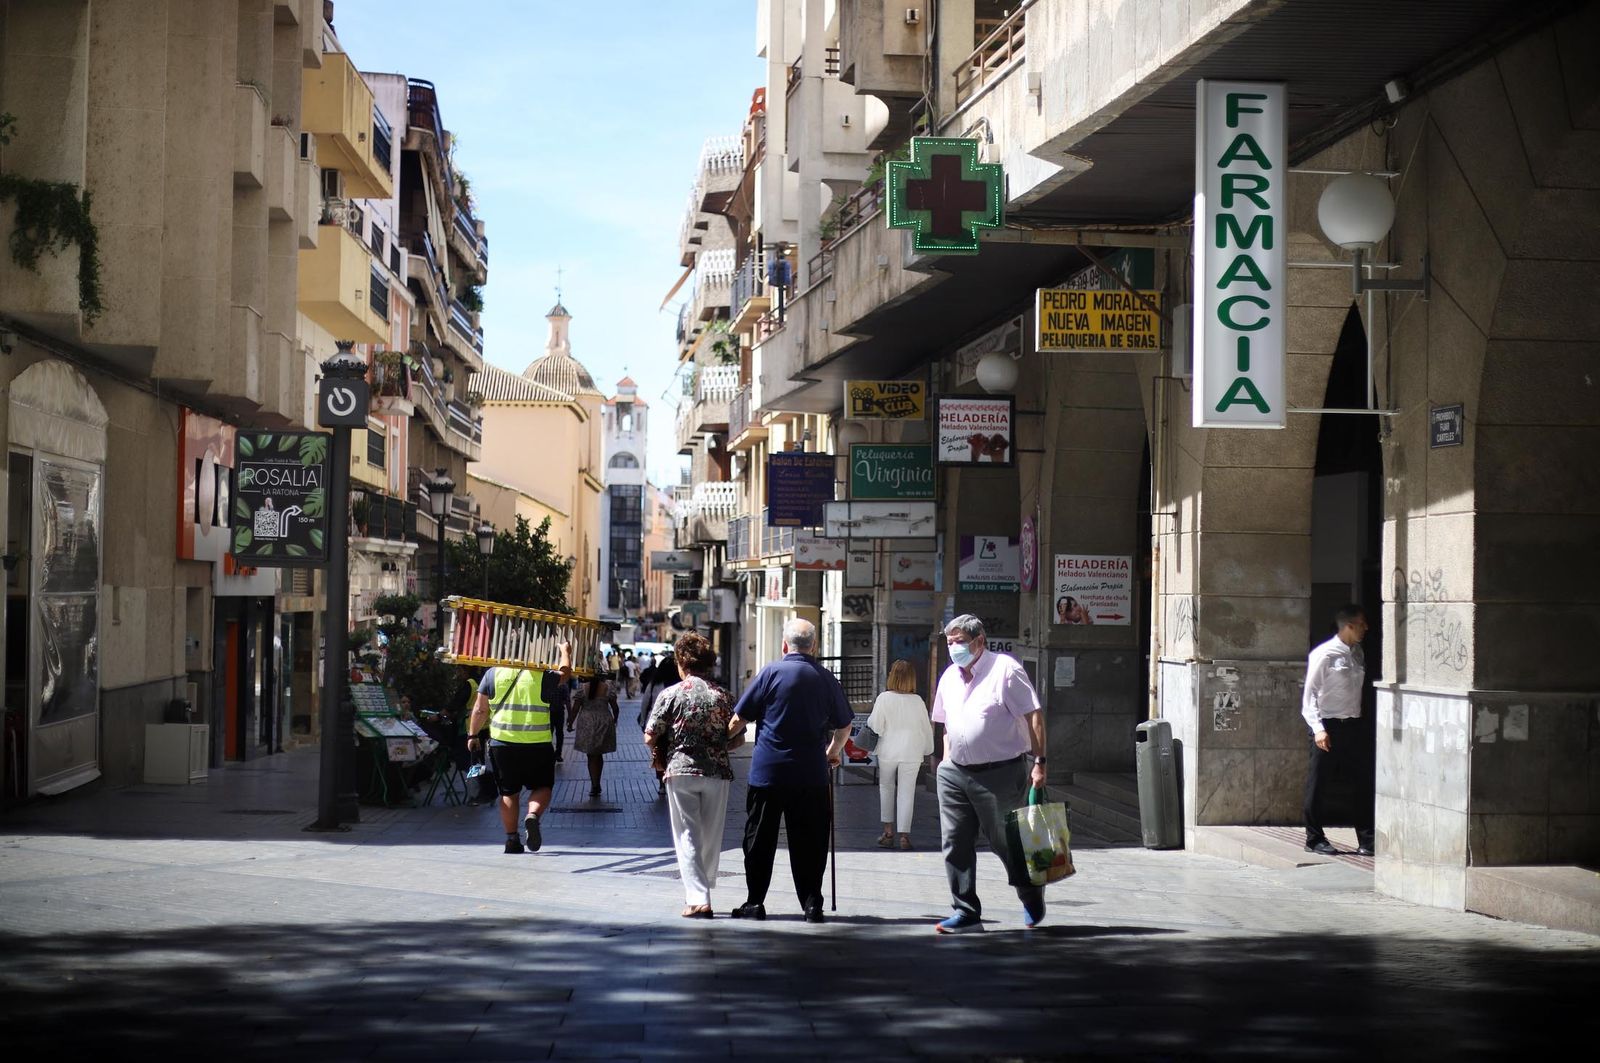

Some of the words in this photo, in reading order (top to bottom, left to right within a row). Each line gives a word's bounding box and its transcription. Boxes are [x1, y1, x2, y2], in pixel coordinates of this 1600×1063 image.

[1215, 93, 1273, 413] FARMACIA
[1043, 292, 1086, 310] PEDRO
[1093, 293, 1156, 311] MORALES
[1048, 312, 1090, 330] NUEVA
[1101, 313, 1151, 331] IMAGEN
[1042, 333, 1106, 348] PELUQUERIA
[1110, 334, 1123, 347] DE
[1127, 334, 1158, 348] SRAS.
[884, 401, 913, 412] CLUB
[941, 412, 1008, 423] HELADERÍA
[244, 467, 318, 487] ROSALÍA
[855, 460, 932, 489] Virginia
[263, 488, 271, 496] LA
[272, 488, 300, 496] RATONA
[1057, 558, 1128, 570] HELADERÍA
[1060, 583, 1098, 593] Elaboración
[1100, 582, 1123, 591] Propia
